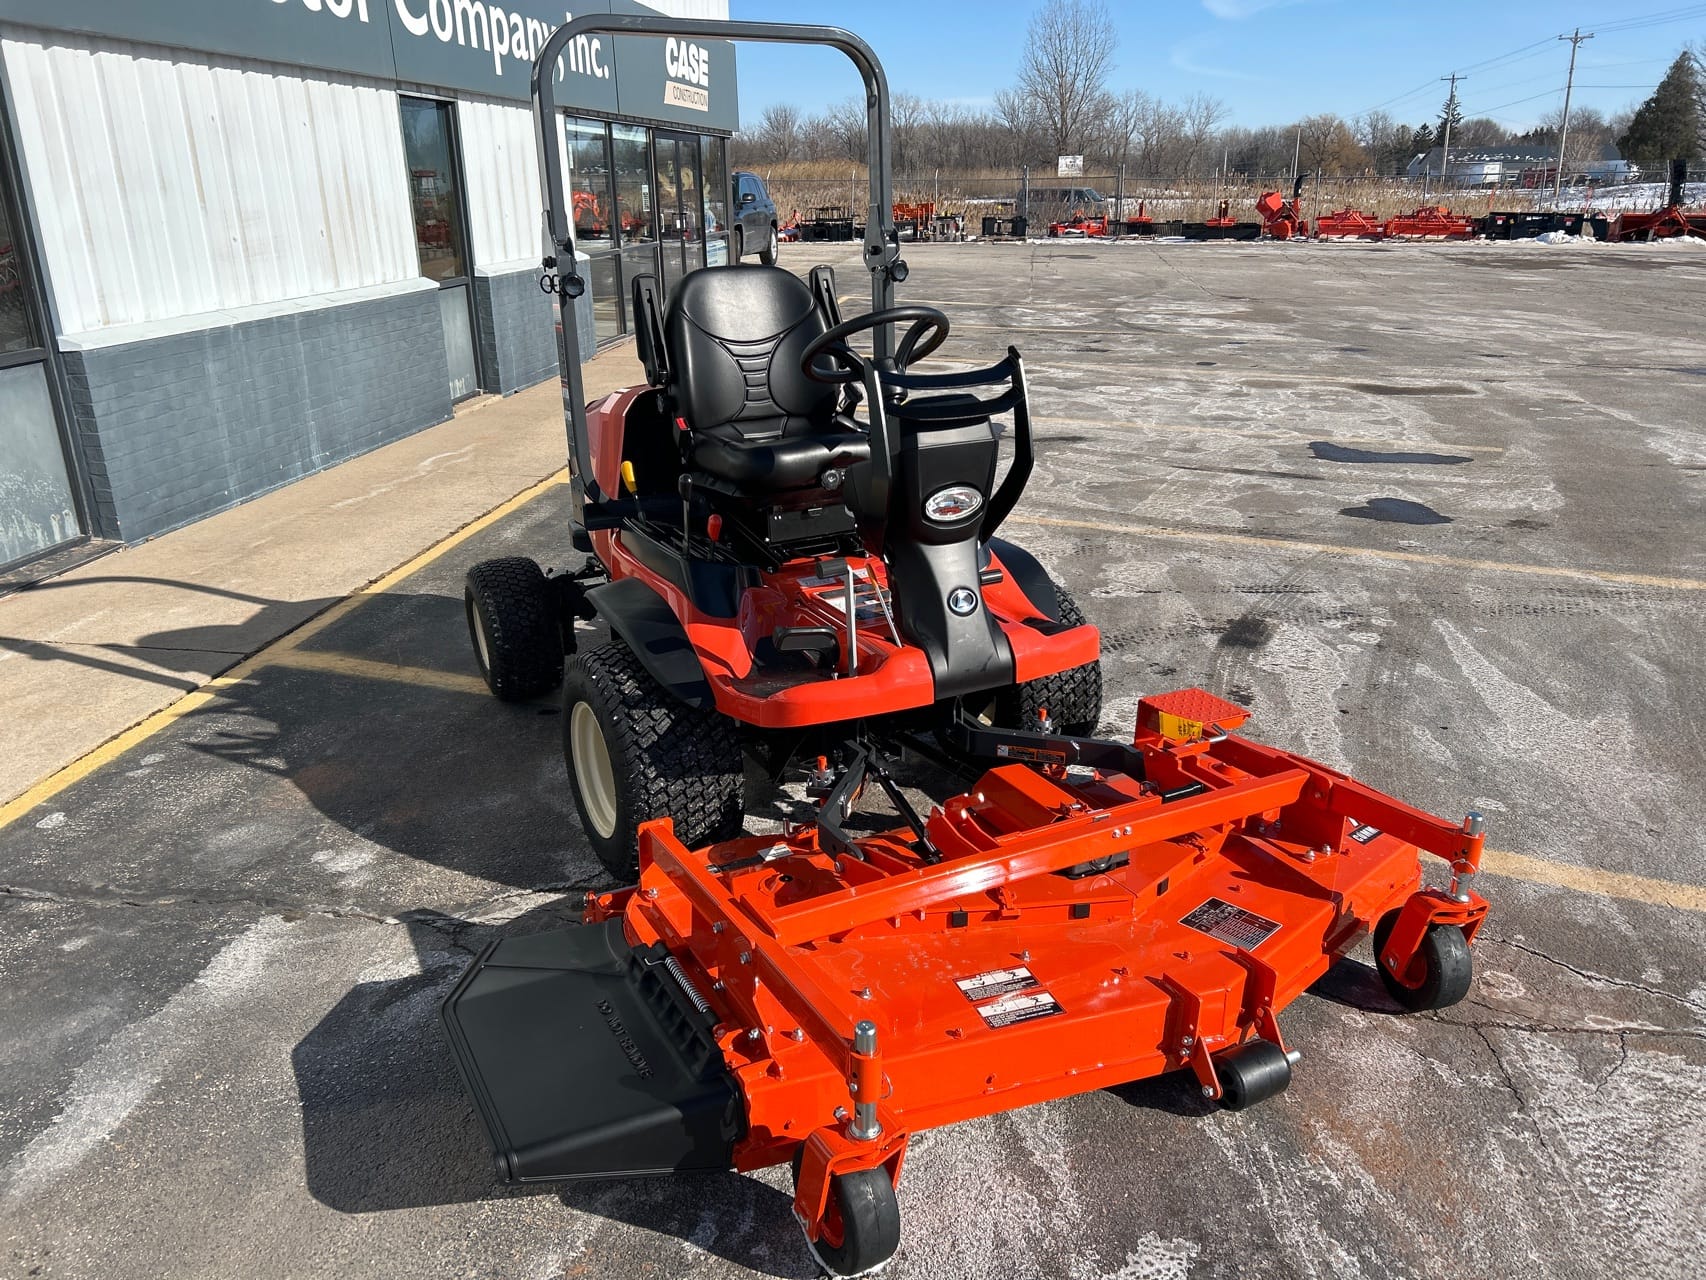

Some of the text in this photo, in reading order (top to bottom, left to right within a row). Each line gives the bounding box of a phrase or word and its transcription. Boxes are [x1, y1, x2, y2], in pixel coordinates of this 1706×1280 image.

[566, 12, 609, 79] Inc.
[665, 37, 709, 87] CASE
[672, 85, 708, 107] CONSTRUCTION
[595, 999, 653, 1080] DO NOT REMOVE
